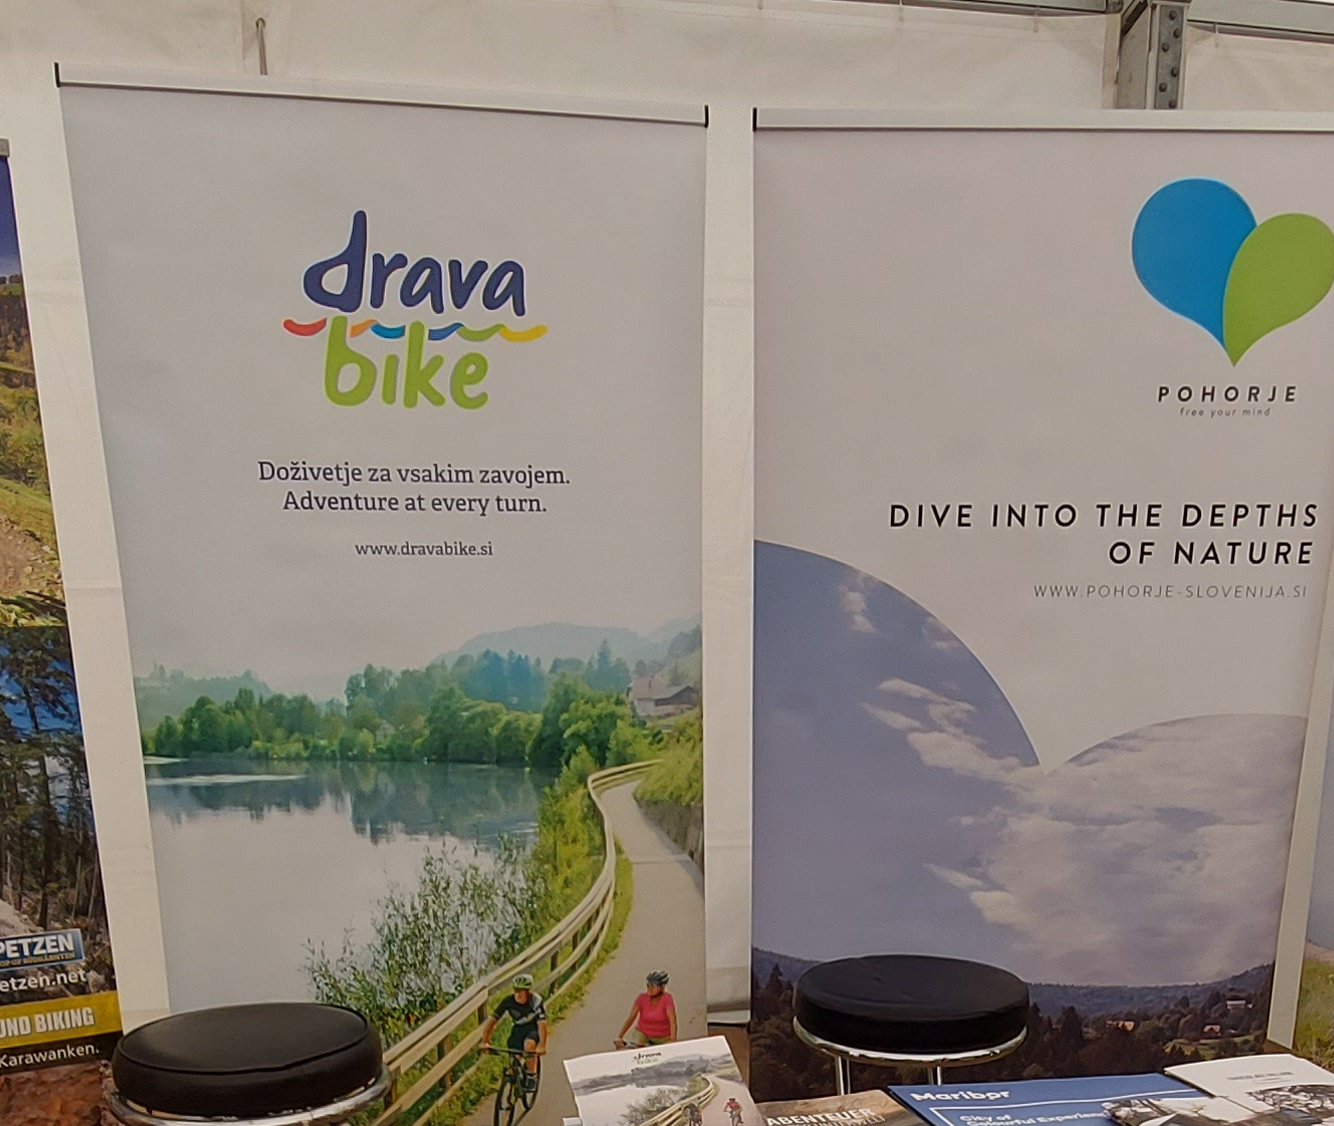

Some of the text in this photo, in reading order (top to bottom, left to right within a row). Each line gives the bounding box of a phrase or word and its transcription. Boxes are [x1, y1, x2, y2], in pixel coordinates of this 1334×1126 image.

[304, 210, 525, 317] drava
[325, 316, 489, 410] bike
[1158, 386, 1297, 402] POHORJE
[1179, 407, 1271, 419] free your mind
[258, 460, 570, 488] Doživetje za vsakim zavojem.
[283, 490, 547, 516] Adventure at every turn.
[890, 504, 1318, 528] DIVE INTO THE DEPTHS
[355, 541, 493, 556] www.dravabike.si
[1109, 541, 1313, 565] OF NATURE
[1034, 585, 1307, 598] WWW.POHORJE-SLOVENIJA.SI
[35, 1007, 95, 1033] BIKING
[910, 1090, 1010, 1101] Maribor
[767, 1108, 875, 1126] ABENTEUER
